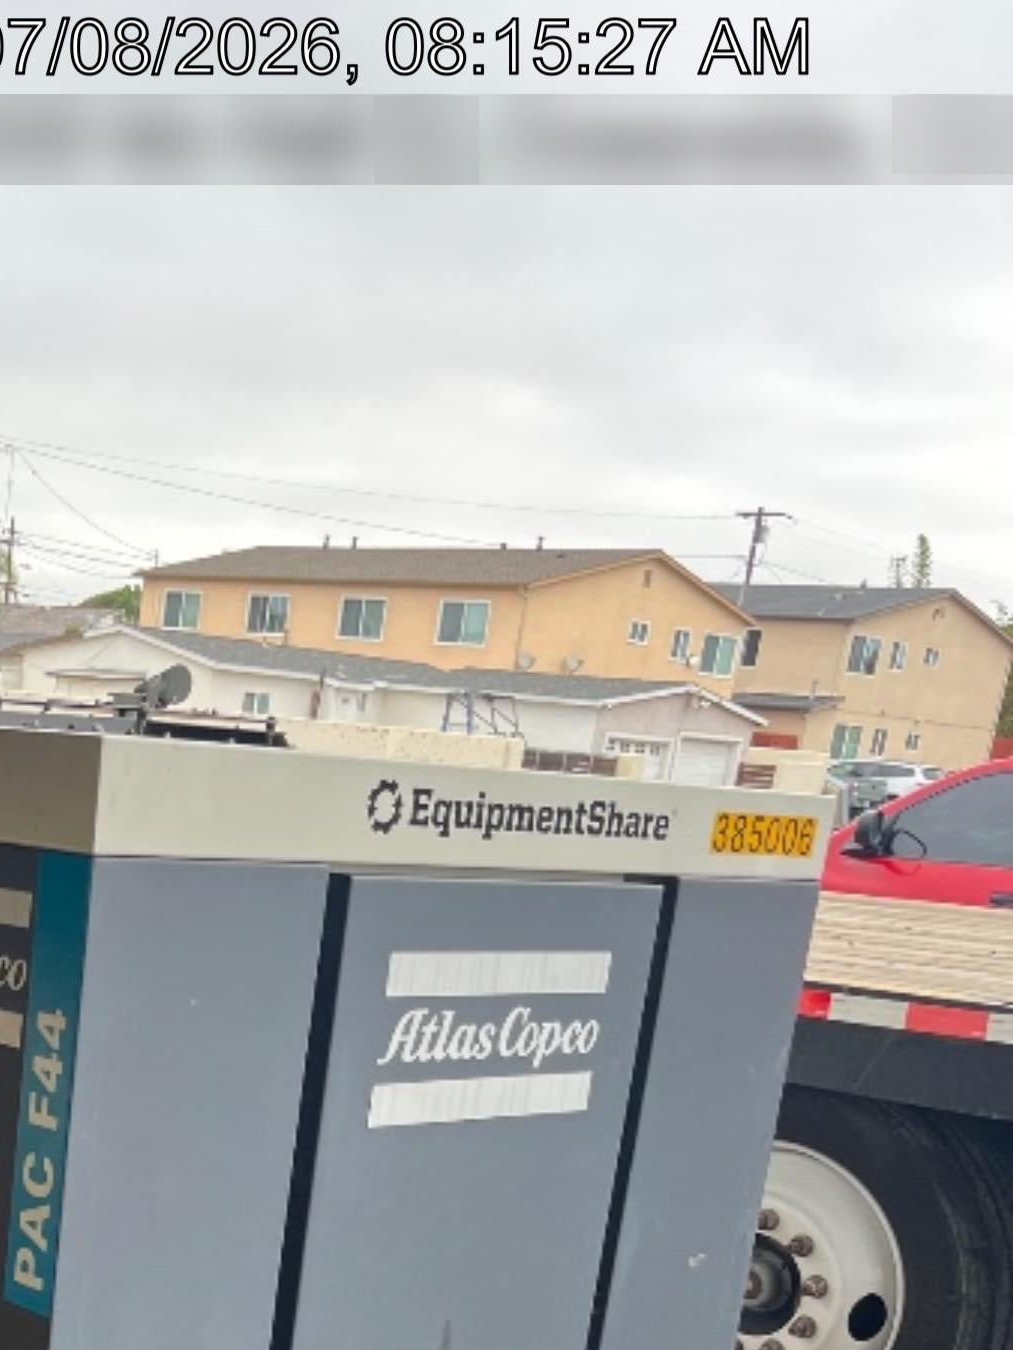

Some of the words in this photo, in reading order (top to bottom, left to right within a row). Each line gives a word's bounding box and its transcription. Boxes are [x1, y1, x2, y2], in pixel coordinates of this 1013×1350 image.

[409, 787, 670, 842] EquipmentShare
[711, 812, 817, 857] 385006
[376, 1006, 495, 1066] Atlas
[498, 1005, 600, 1069] Copco
[28, 1008, 68, 1132] F44
[13, 1151, 55, 1292] PAC
